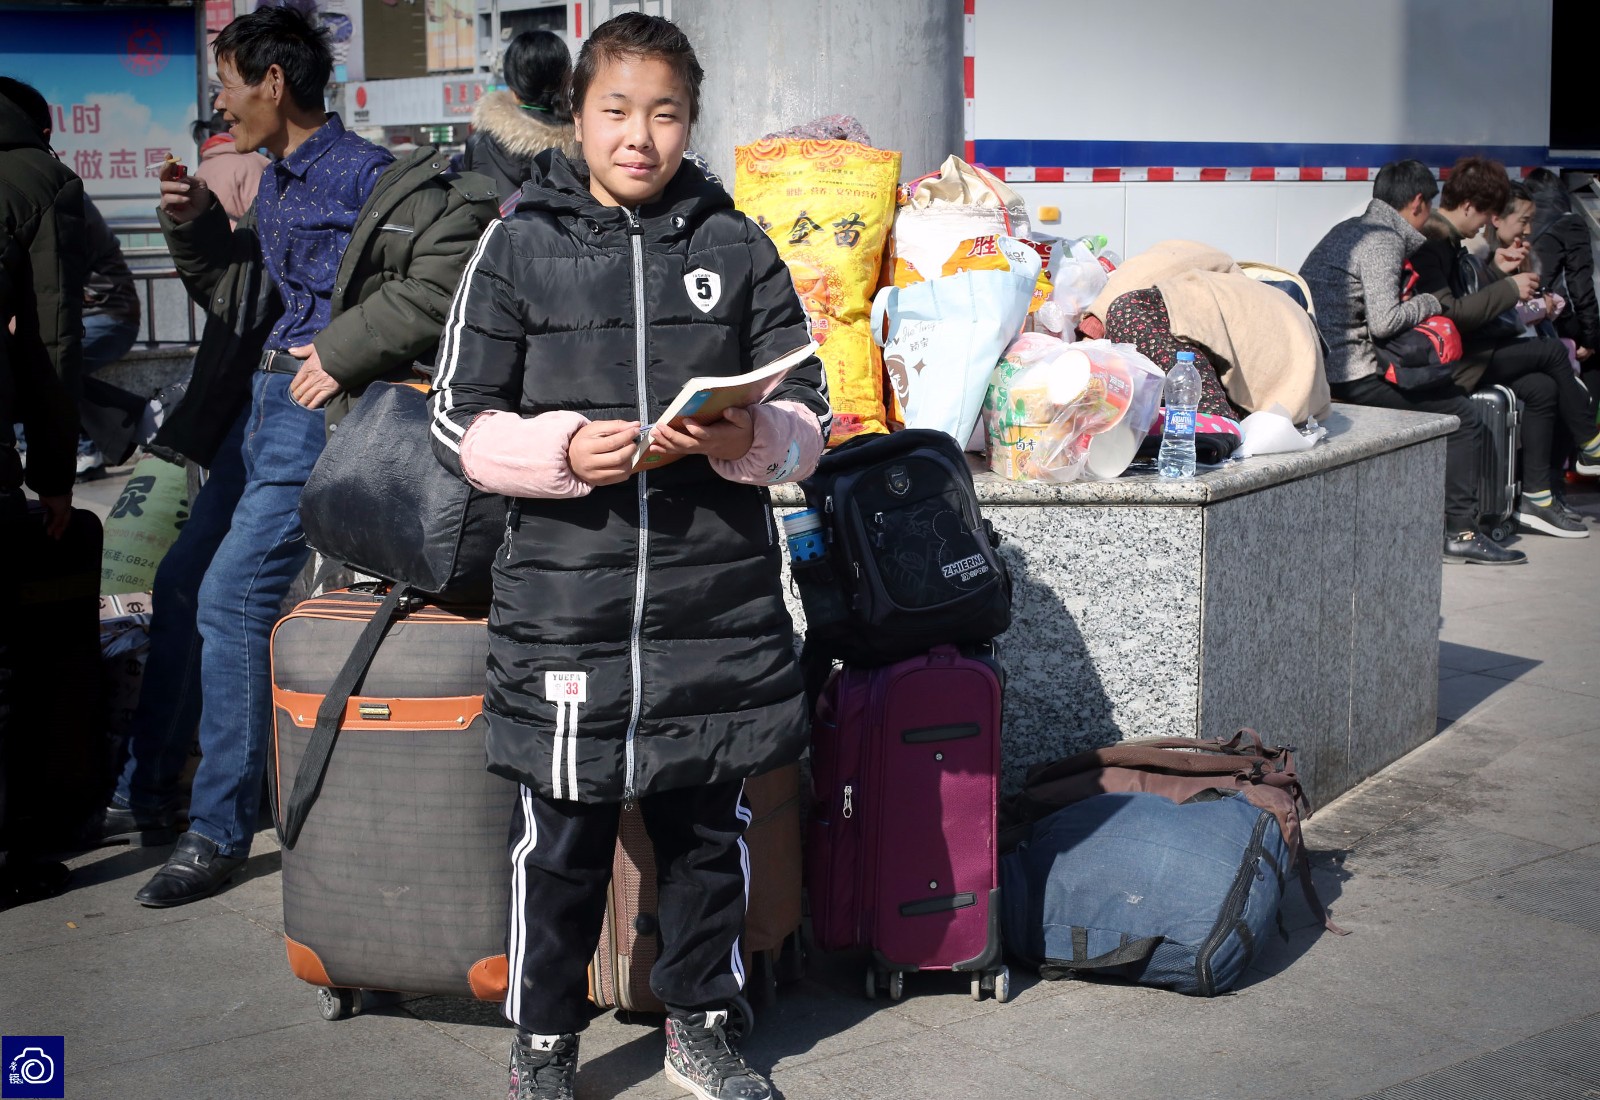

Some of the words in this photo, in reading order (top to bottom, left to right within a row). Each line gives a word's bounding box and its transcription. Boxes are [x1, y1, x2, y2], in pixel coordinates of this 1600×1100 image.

[58, 148, 172, 179] 做志愿
[968, 235, 998, 256] 胜
[695, 278, 713, 300] 5
[942, 553, 986, 578] ZHIERNA
[566, 682, 579, 695] 33
